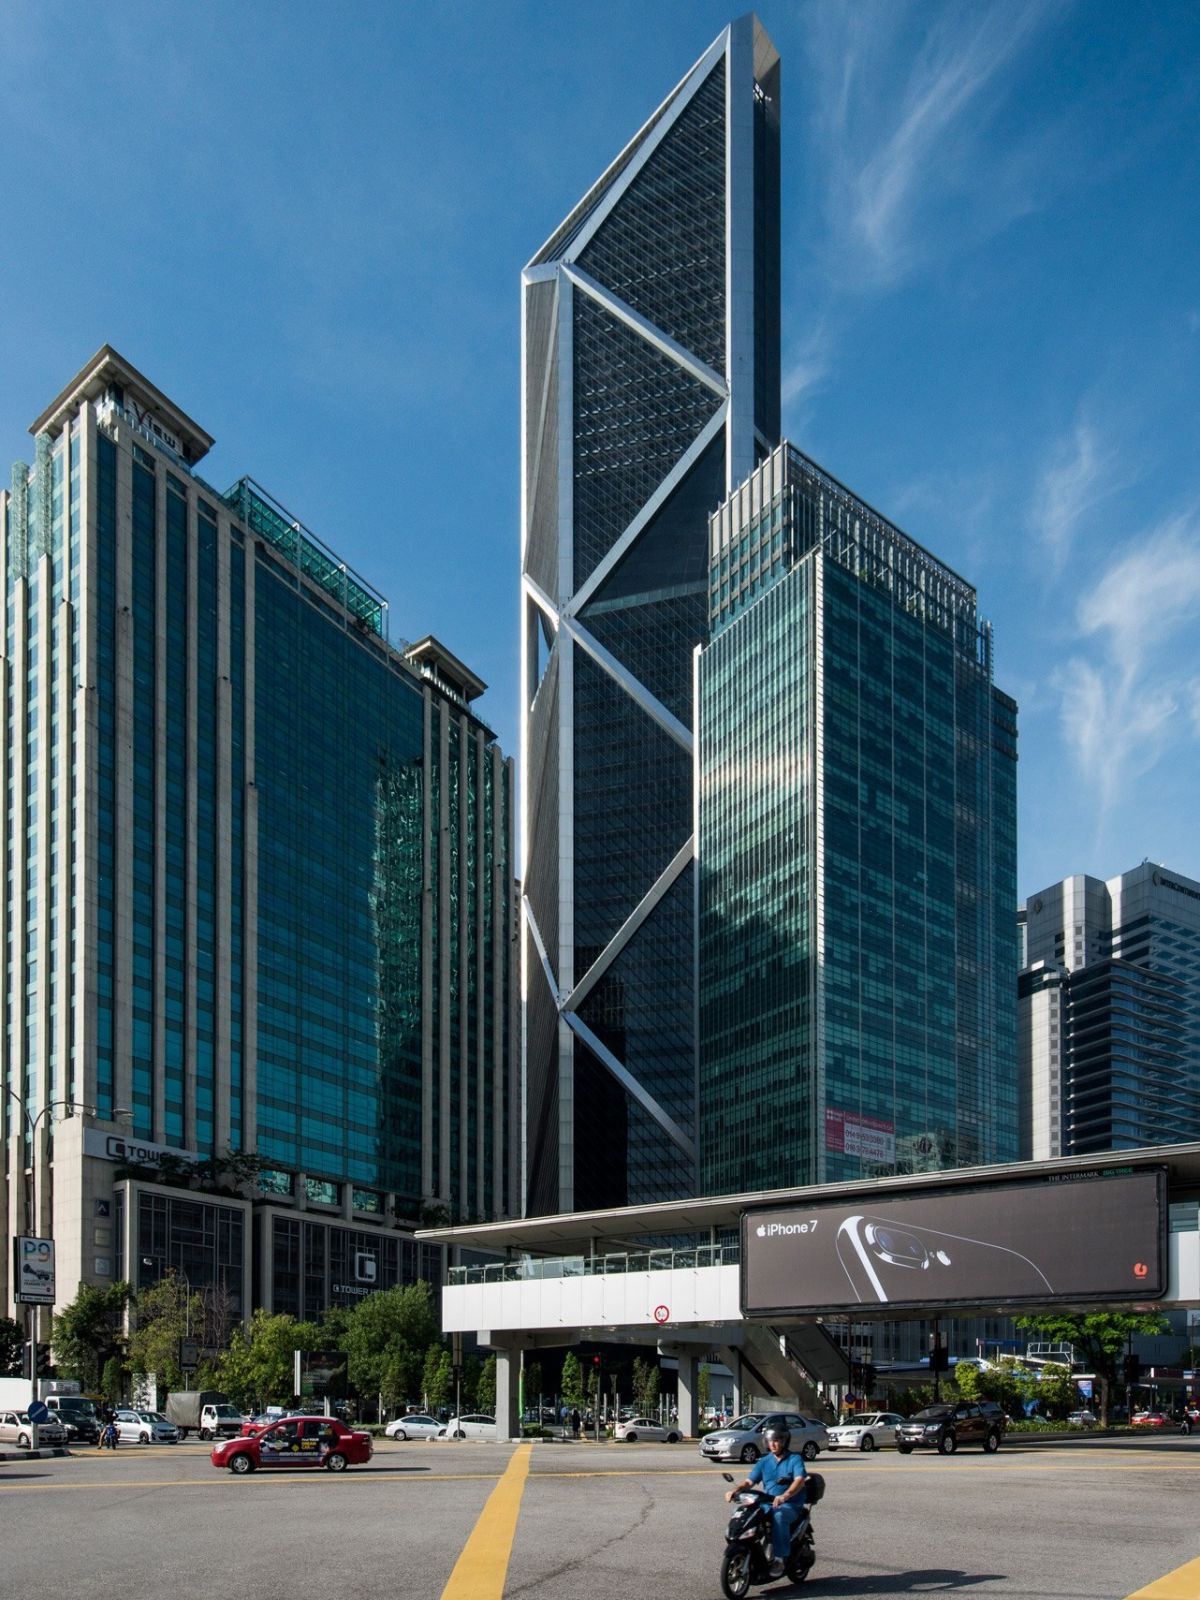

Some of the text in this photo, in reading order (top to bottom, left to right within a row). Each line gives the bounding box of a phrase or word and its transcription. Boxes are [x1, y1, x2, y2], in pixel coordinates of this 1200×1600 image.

[767, 1219, 818, 1236] iPhone 7
[24, 1241, 50, 1262] P9
[341, 1285, 369, 1296] TOWER
